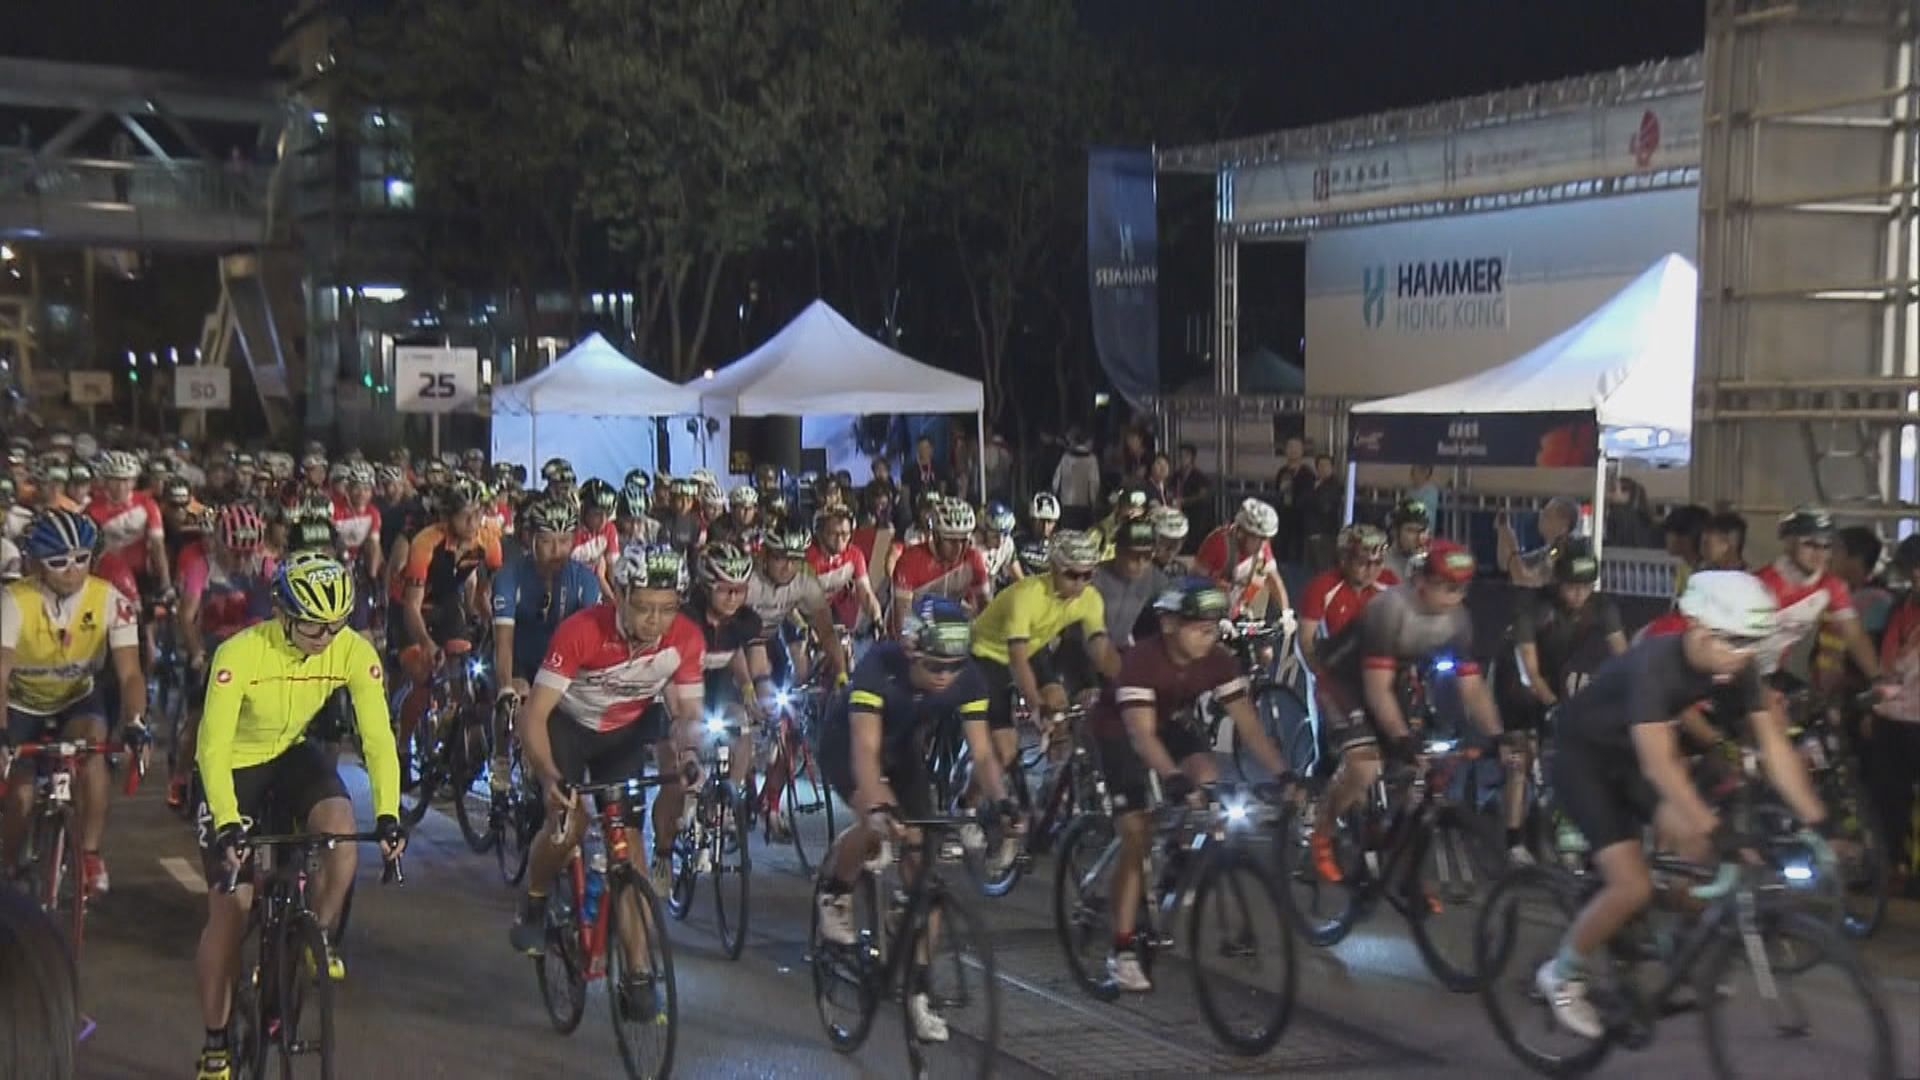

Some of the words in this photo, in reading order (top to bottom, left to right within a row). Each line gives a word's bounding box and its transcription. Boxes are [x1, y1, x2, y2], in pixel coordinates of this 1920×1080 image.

[1398, 257, 1503, 299] HAMMER
[1397, 302, 1449, 331] HONG
[1453, 300, 1505, 329] KONG
[191, 382, 216, 399] 50
[418, 372, 456, 398] 25
